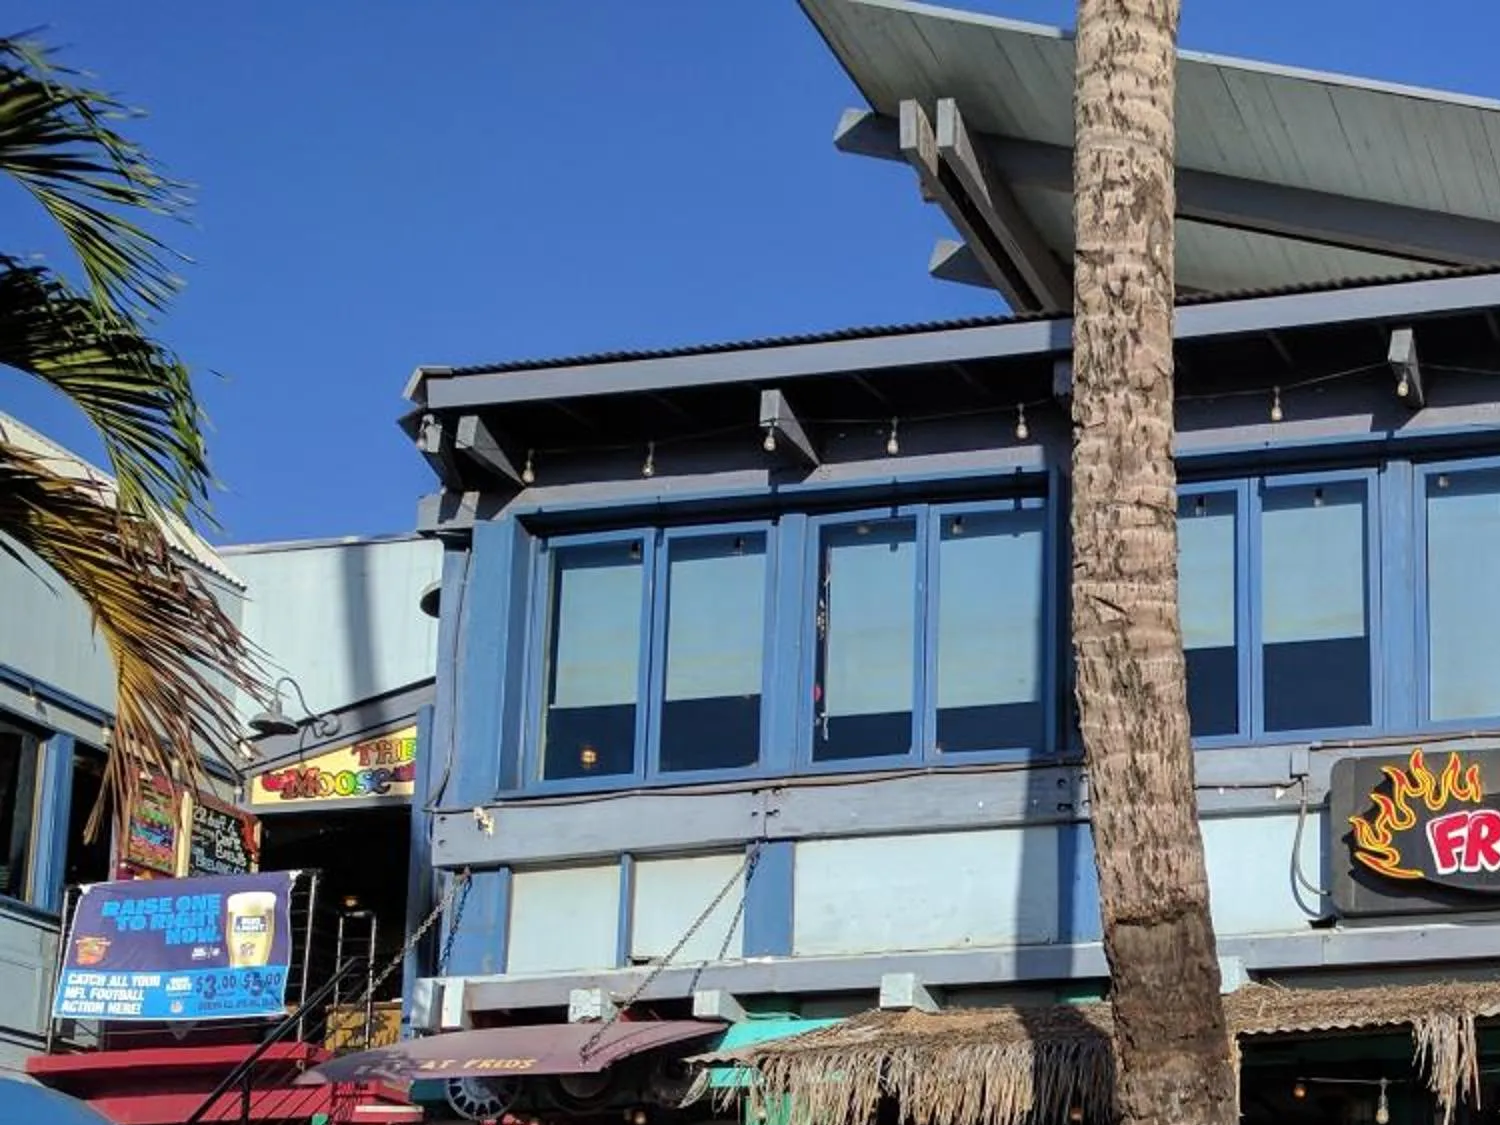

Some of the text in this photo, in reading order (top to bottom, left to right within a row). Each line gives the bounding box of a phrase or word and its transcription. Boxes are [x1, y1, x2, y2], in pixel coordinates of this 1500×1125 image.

[352, 737, 417, 766] THE
[102, 892, 222, 917] RAISE ONE
[115, 909, 217, 931] TO RIGHT
[67, 973, 162, 988] CATCH ALL YOUR
[64, 986, 145, 1001] NFL FOOTBALL
[61, 1000, 104, 1014] ACTION
